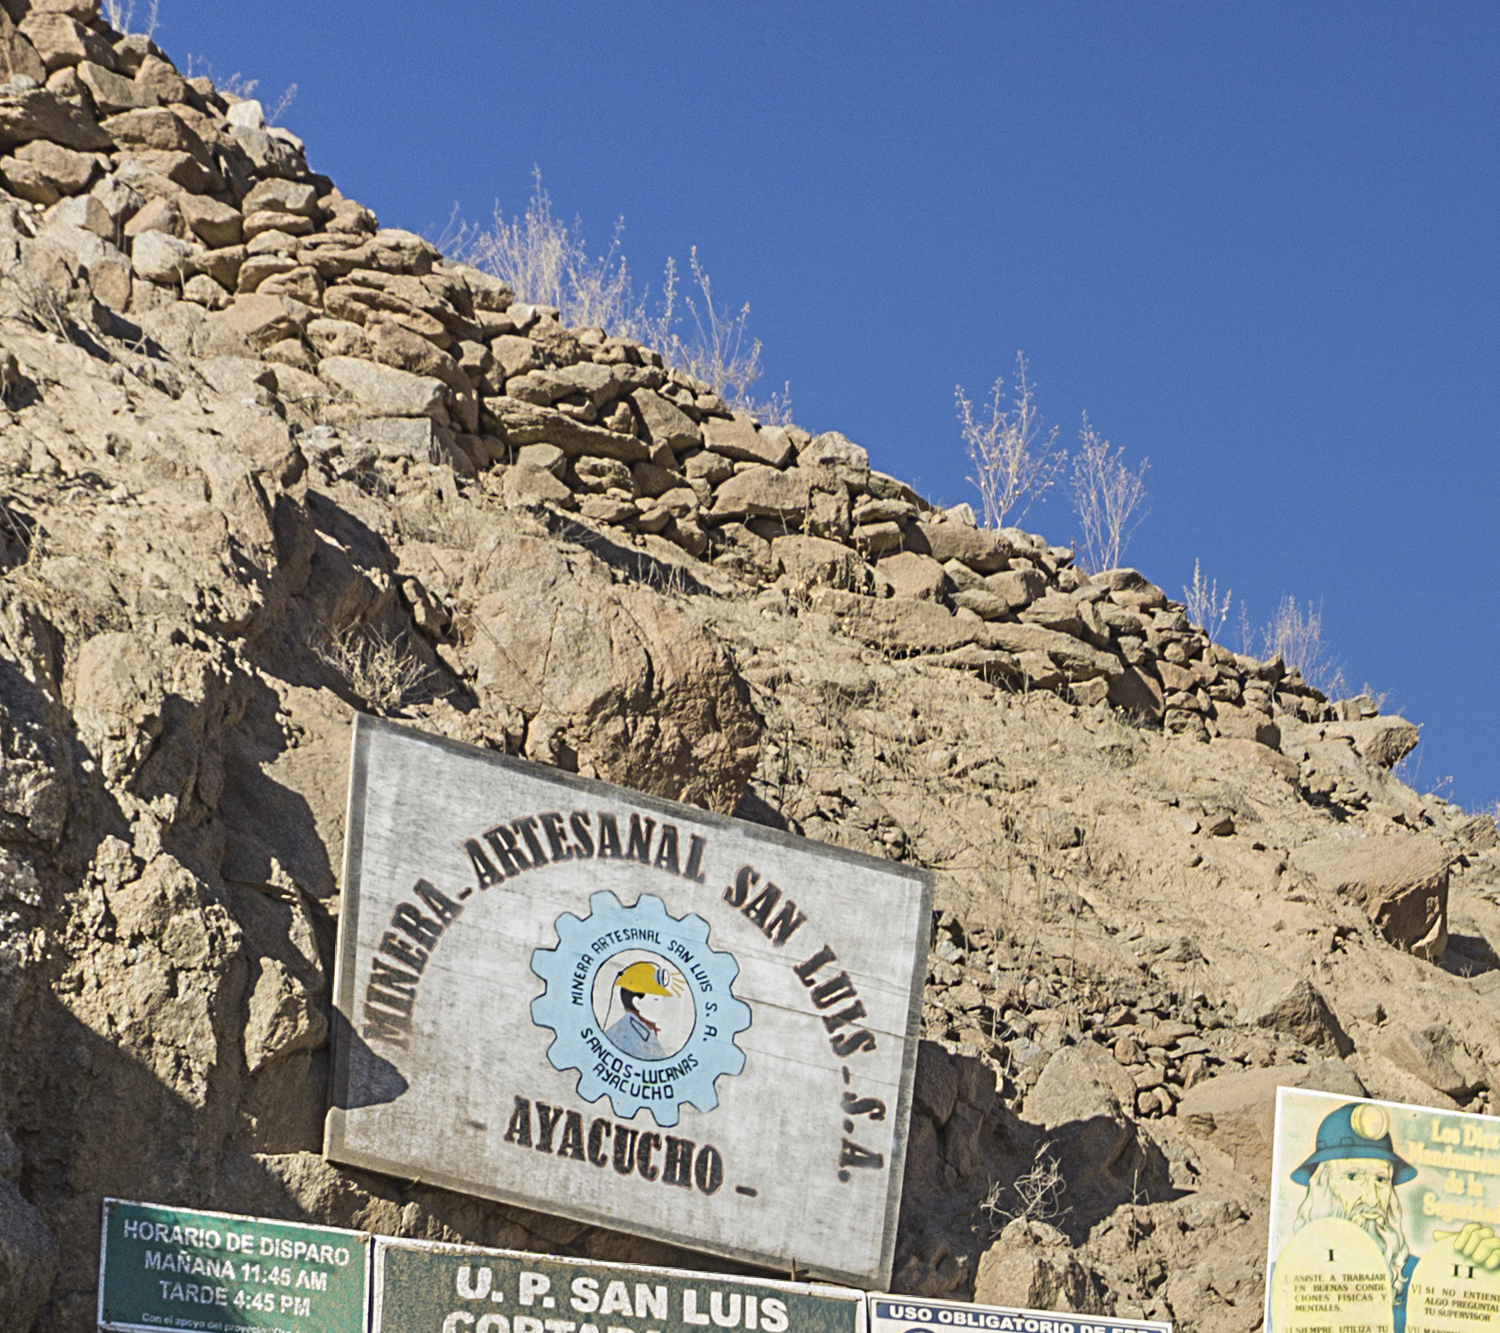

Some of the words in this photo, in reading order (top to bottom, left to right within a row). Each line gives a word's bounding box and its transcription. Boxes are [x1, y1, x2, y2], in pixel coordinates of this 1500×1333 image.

[462, 809, 706, 890] ARTESANAL
[723, 865, 806, 946] SAN
[793, 943, 878, 1058] LUIS
[572, 953, 594, 1006] MINERA
[591, 928, 662, 954] ARTESANAL
[667, 940, 694, 963] SAN
[690, 963, 713, 993] LUIS
[593, 1063, 674, 1100] AYACUCHO
[504, 1095, 725, 1197] AYACUCHO
[1431, 1120, 1460, 1144] Los
[1464, 1124, 1499, 1150] Diez
[1445, 1171, 1464, 1194] de
[1468, 1173, 1483, 1197] la
[124, 1219, 221, 1249] HORARIO
[226, 1232, 254, 1254] DE
[260, 1237, 350, 1266] DISPARO
[145, 1250, 235, 1280] MAÑANA
[242, 1263, 291, 1286] 11:45
[296, 1271, 327, 1291] AM
[1294, 1274, 1323, 1282] ASISTE
[1342, 1273, 1386, 1281] TRABAJAR
[159, 1280, 228, 1306] TARDE
[233, 1290, 275, 1312] 4:45
[281, 1295, 311, 1316] PM
[456, 1266, 503, 1302] U.
[519, 1271, 555, 1308] P.
[570, 1276, 668, 1320] SAN
[682, 1289, 790, 1333] LUIS
[1294, 1284, 1306, 1292] EN
[1313, 1284, 1348, 1292] BUENAS
[1294, 1294, 1330, 1302] CIONES
[1338, 1294, 1373, 1302] FISICAS
[1425, 1286, 1435, 1294] SI
[1442, 1288, 1456, 1297] NO
[1425, 1297, 1449, 1307] ALGO
[142, 1312, 161, 1323] Con
[175, 1318, 205, 1329] apoyo
[889, 1305, 932, 1321] USO
[1424, 1307, 1435, 1315] TU
[1438, 1309, 1491, 1322] SUPERVISOR
